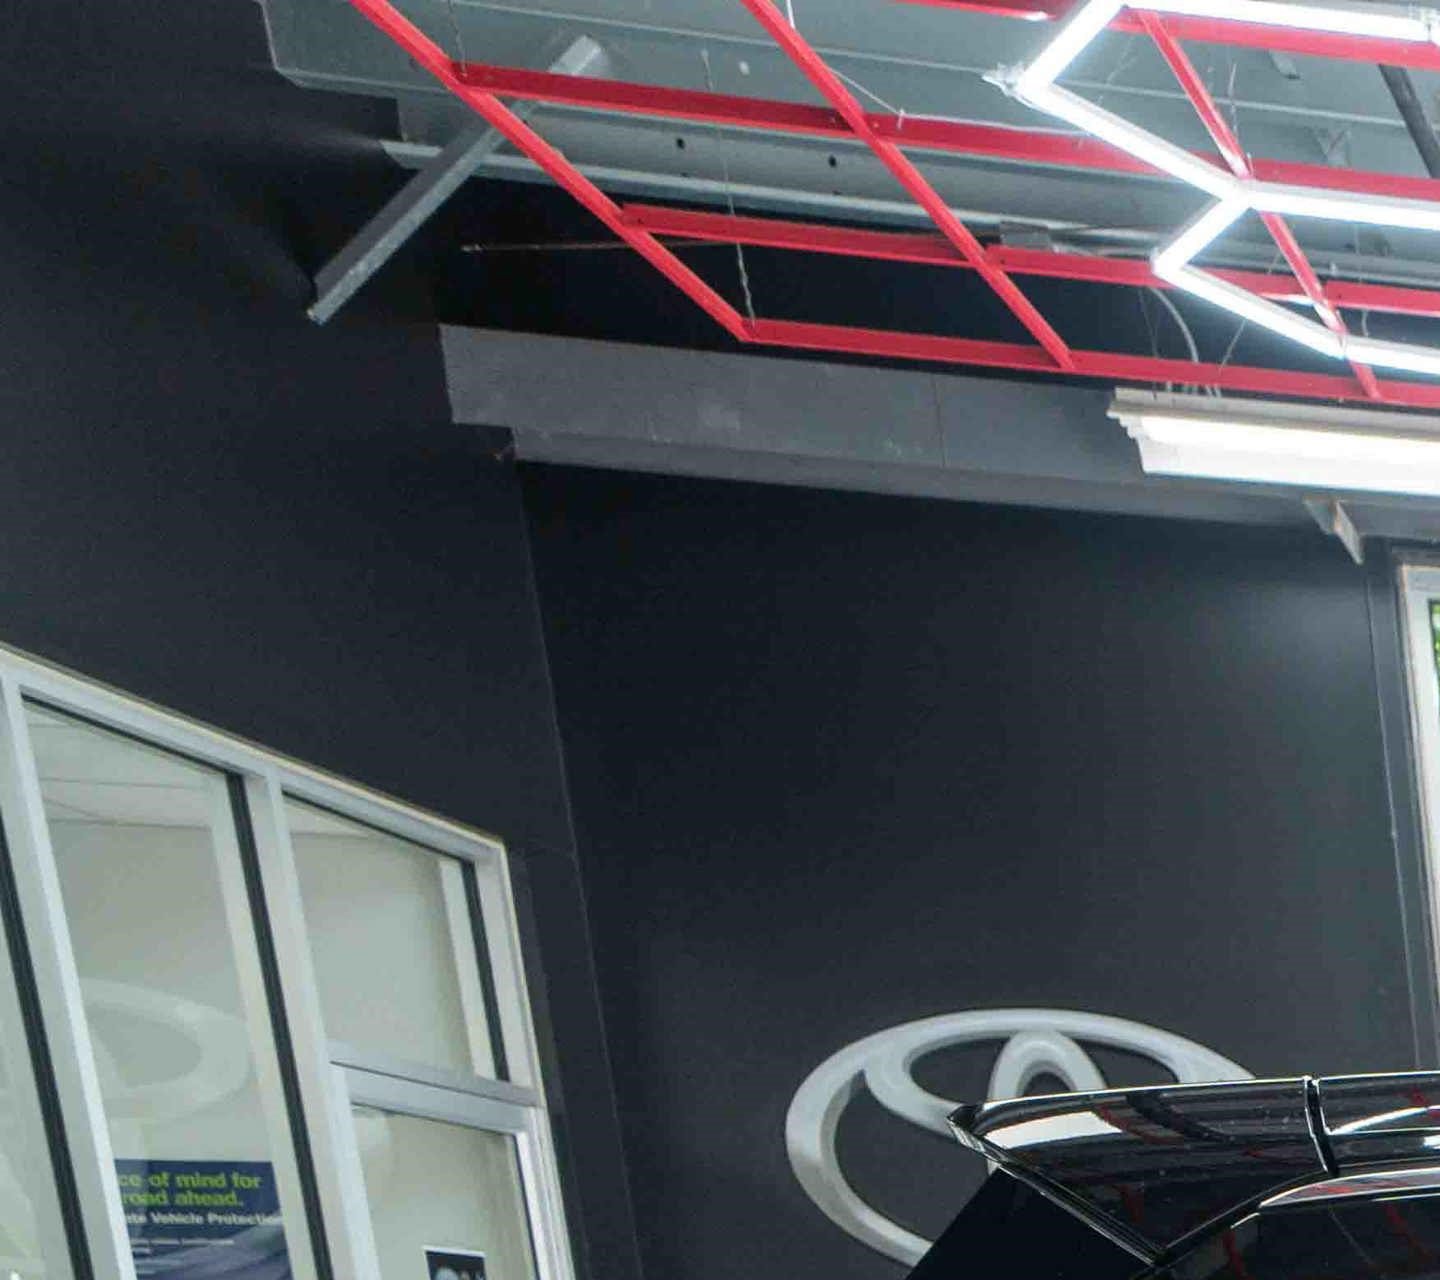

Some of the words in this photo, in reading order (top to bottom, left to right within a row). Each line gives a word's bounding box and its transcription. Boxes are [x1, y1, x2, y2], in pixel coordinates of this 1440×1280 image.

[148, 1172, 169, 1188] of
[175, 1173, 226, 1188] mind
[231, 1172, 262, 1189] for
[174, 1191, 244, 1207] ahead.
[150, 1212, 204, 1224] Vehicle
